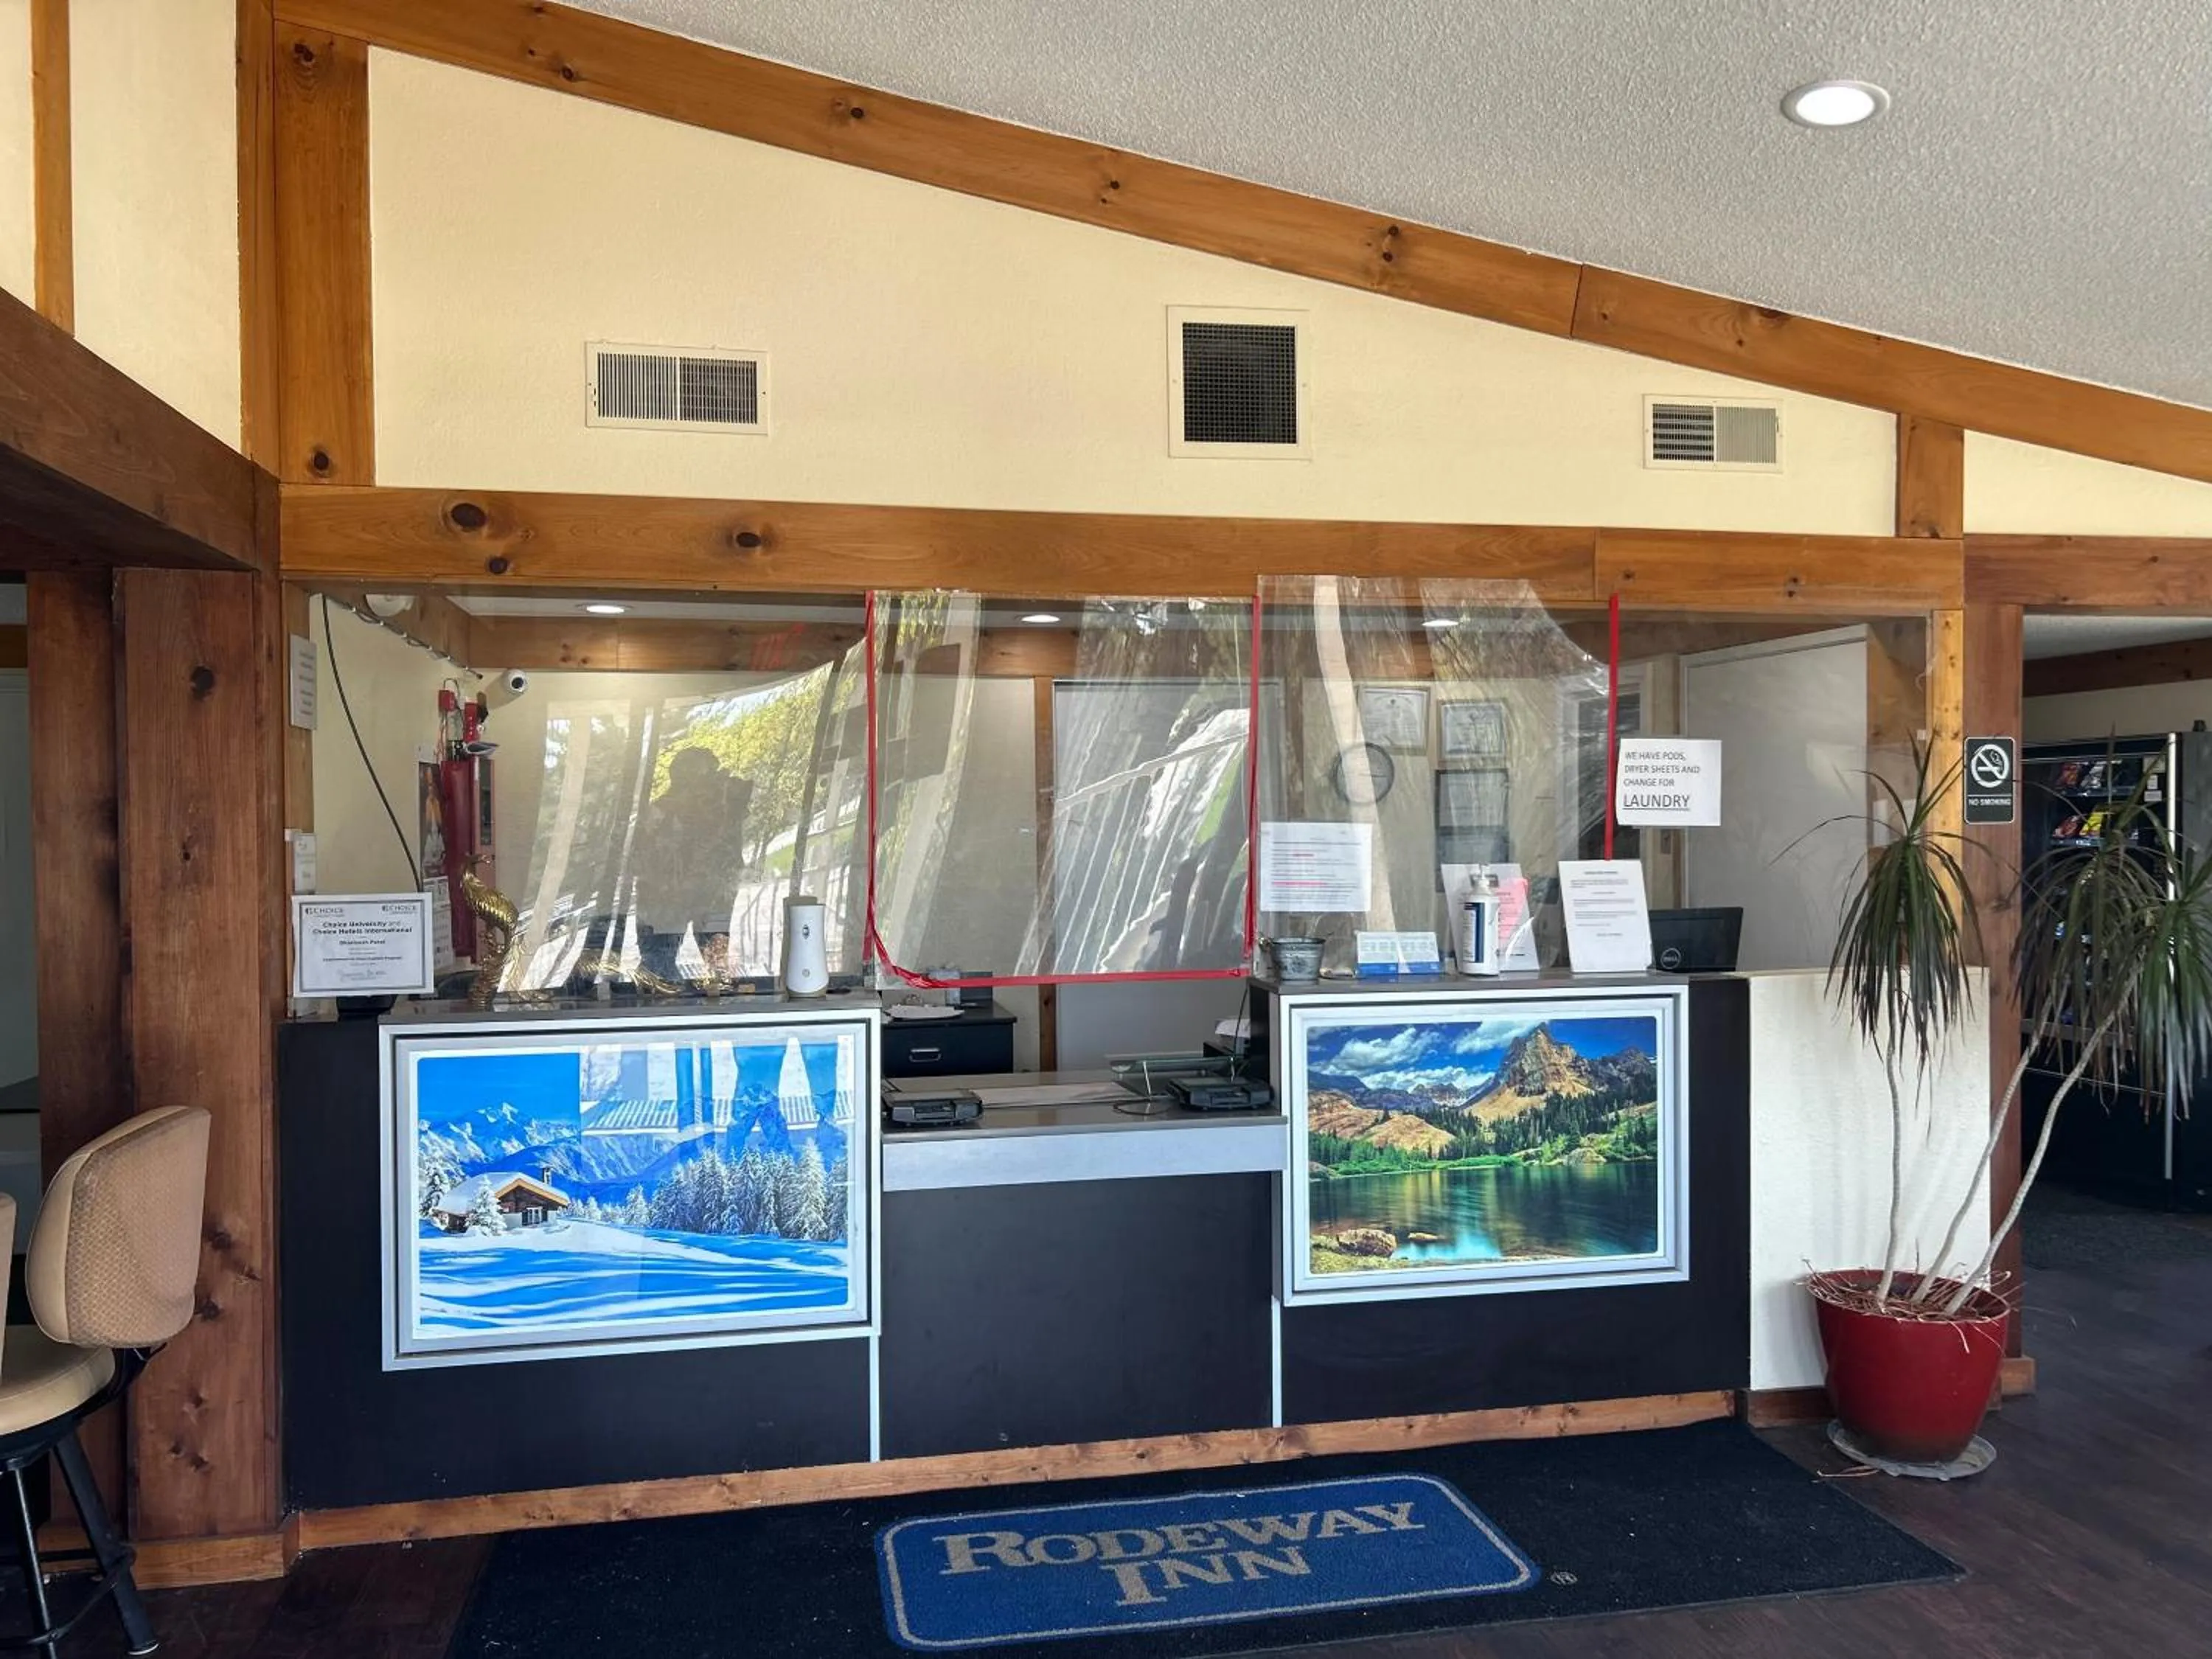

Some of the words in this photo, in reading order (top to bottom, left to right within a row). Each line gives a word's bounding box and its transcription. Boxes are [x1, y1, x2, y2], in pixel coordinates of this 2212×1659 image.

[1625, 751, 1637, 760] WE
[1639, 751, 1660, 760] HAVE
[1624, 765, 1649, 773] DRYER
[1651, 765, 1680, 773] SHEETS
[1681, 765, 1700, 773] AND
[1623, 778, 1657, 787] CHANGE
[1658, 778, 1674, 787] FOR
[1624, 793, 1690, 807] LAUNDRY
[932, 1501, 1425, 1575] RODEWAY
[1099, 1545, 1311, 1606] INN
